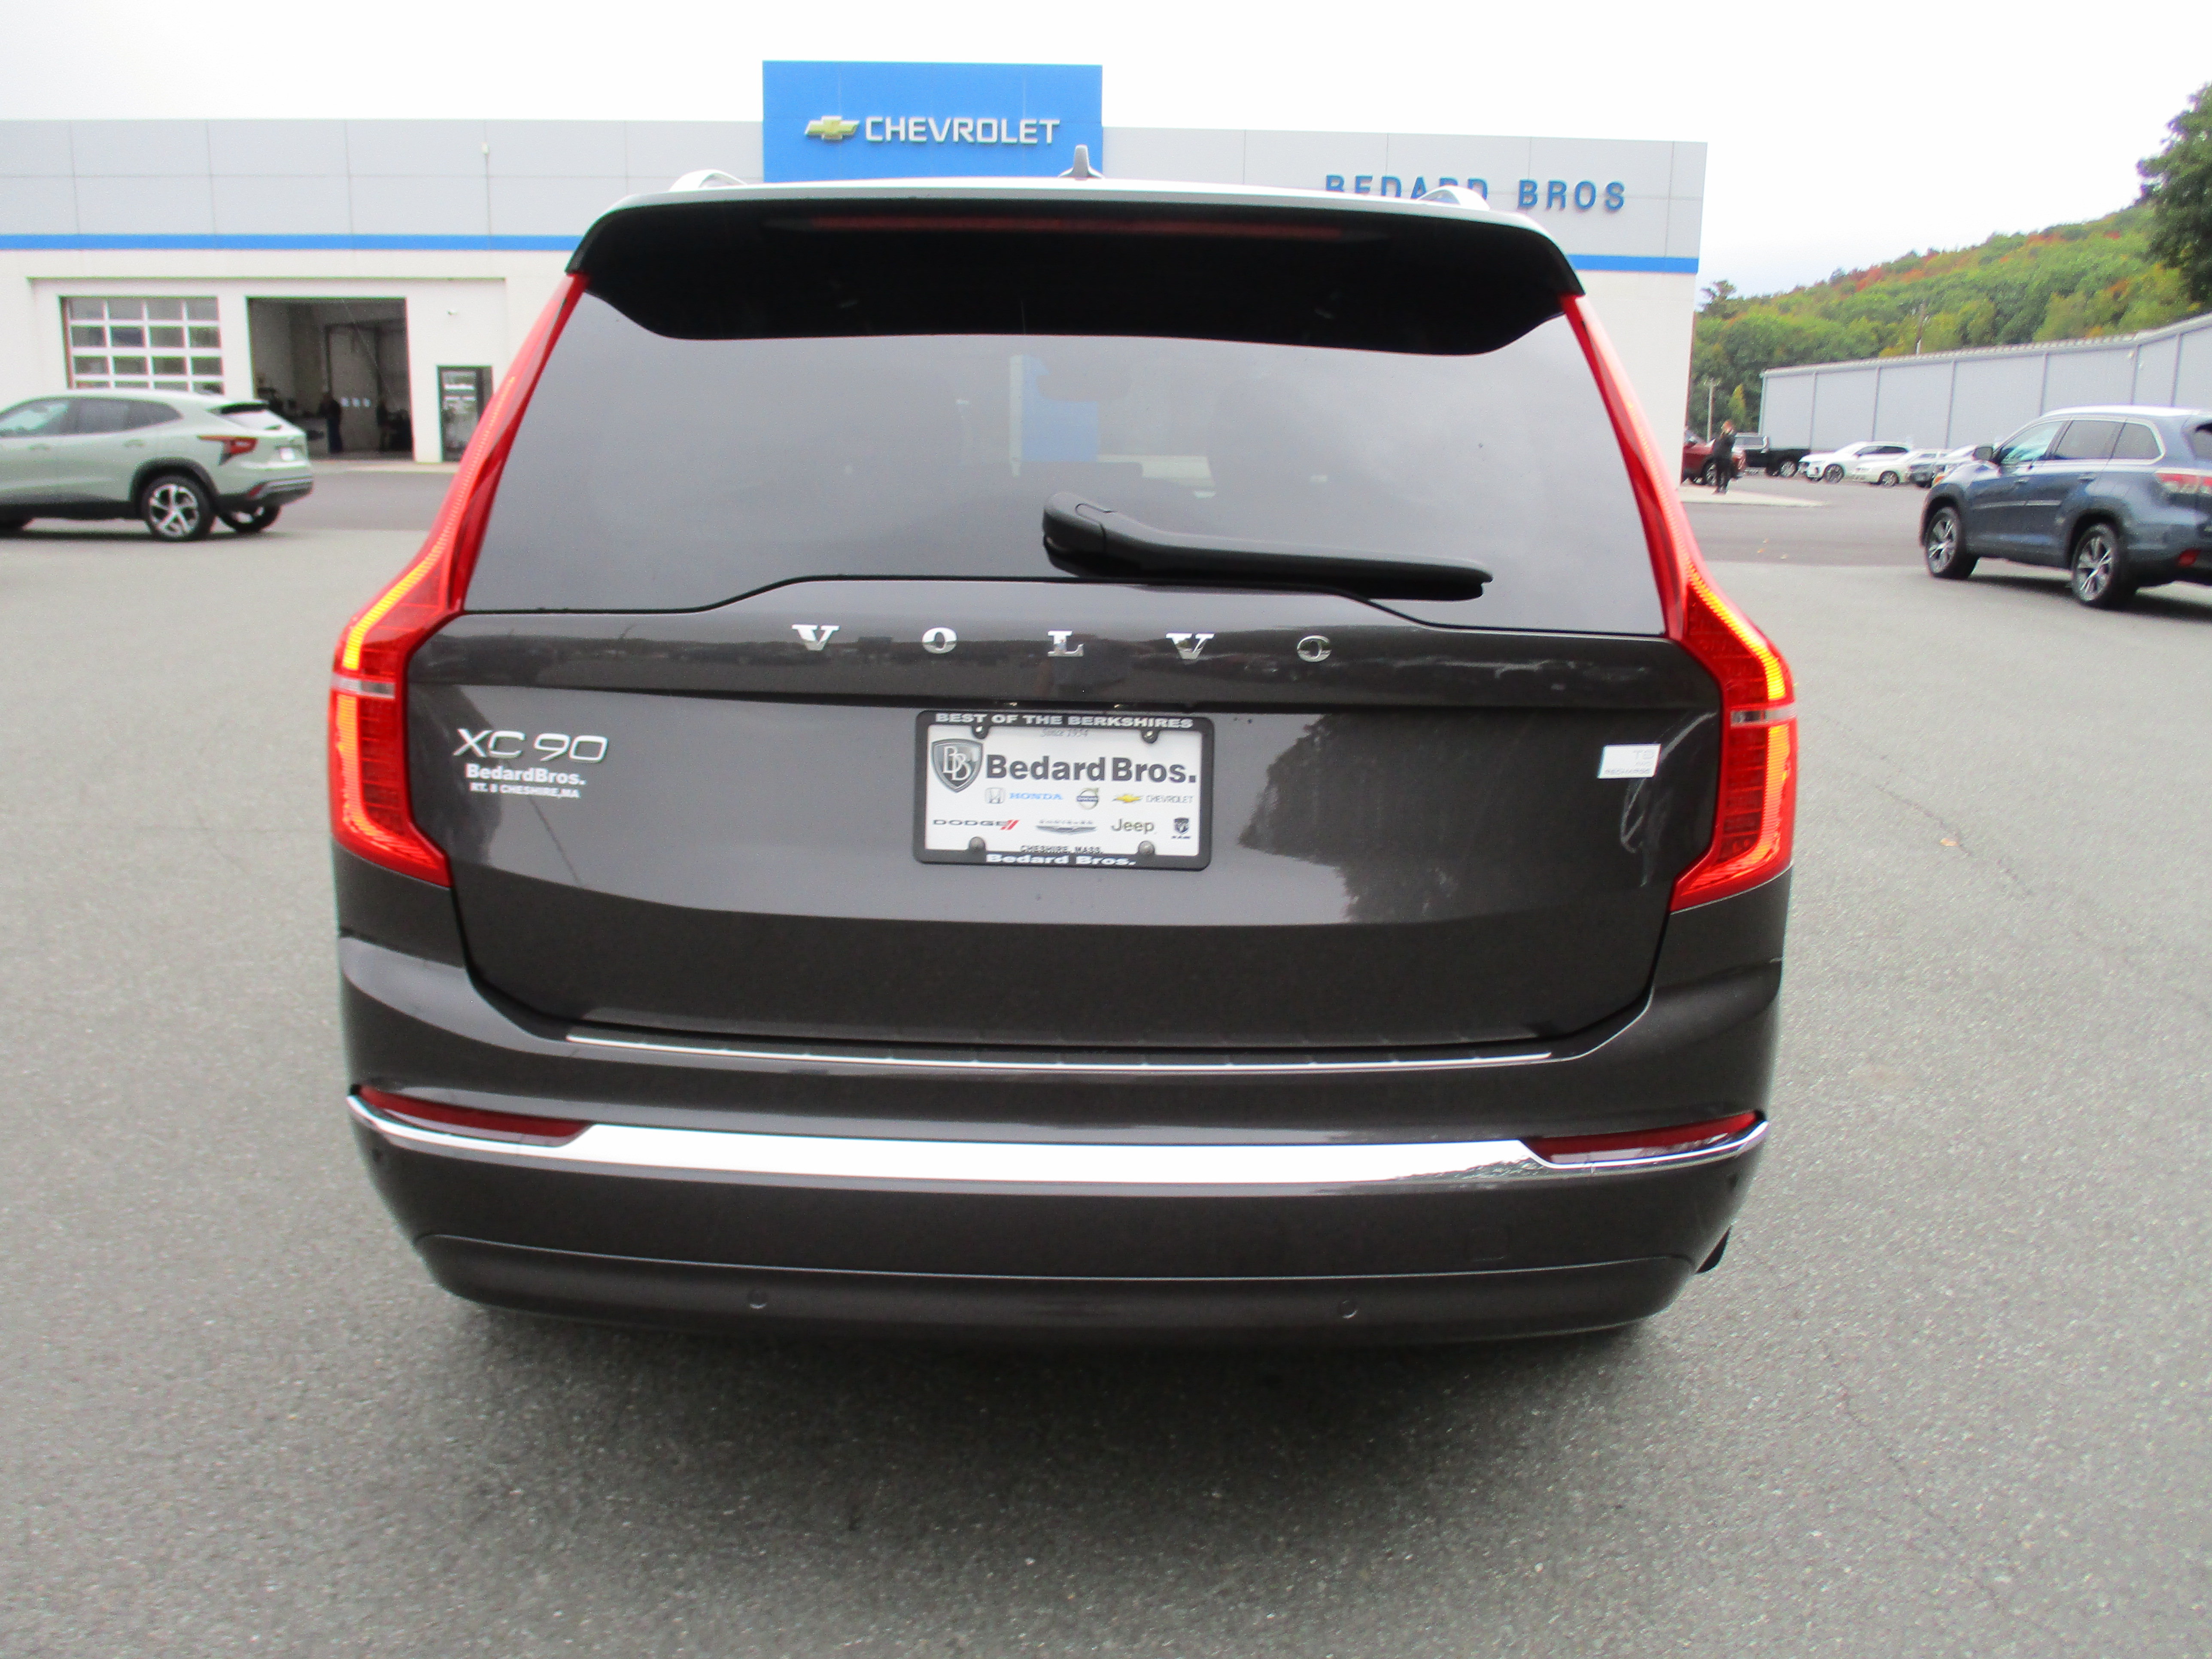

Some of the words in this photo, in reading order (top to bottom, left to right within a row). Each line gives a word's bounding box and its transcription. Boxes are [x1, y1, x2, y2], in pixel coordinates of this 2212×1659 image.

[865, 116, 1060, 144] CHEVROLET
[1517, 179, 1626, 211] BROS
[791, 624, 1332, 663] VOLVO
[935, 713, 988, 723] BEST
[991, 714, 1019, 724] OF
[1022, 714, 1063, 725] THE
[1068, 715, 1194, 729] BERKSHIRES
[986, 754, 1106, 781] Bedard
[1111, 757, 1197, 783] Bros.
[1145, 795, 1194, 803] CHEVROLET
[1111, 818, 1155, 835] Jeep
[986, 853, 1070, 864] Bedard
[1076, 855, 1136, 866] Bros.
